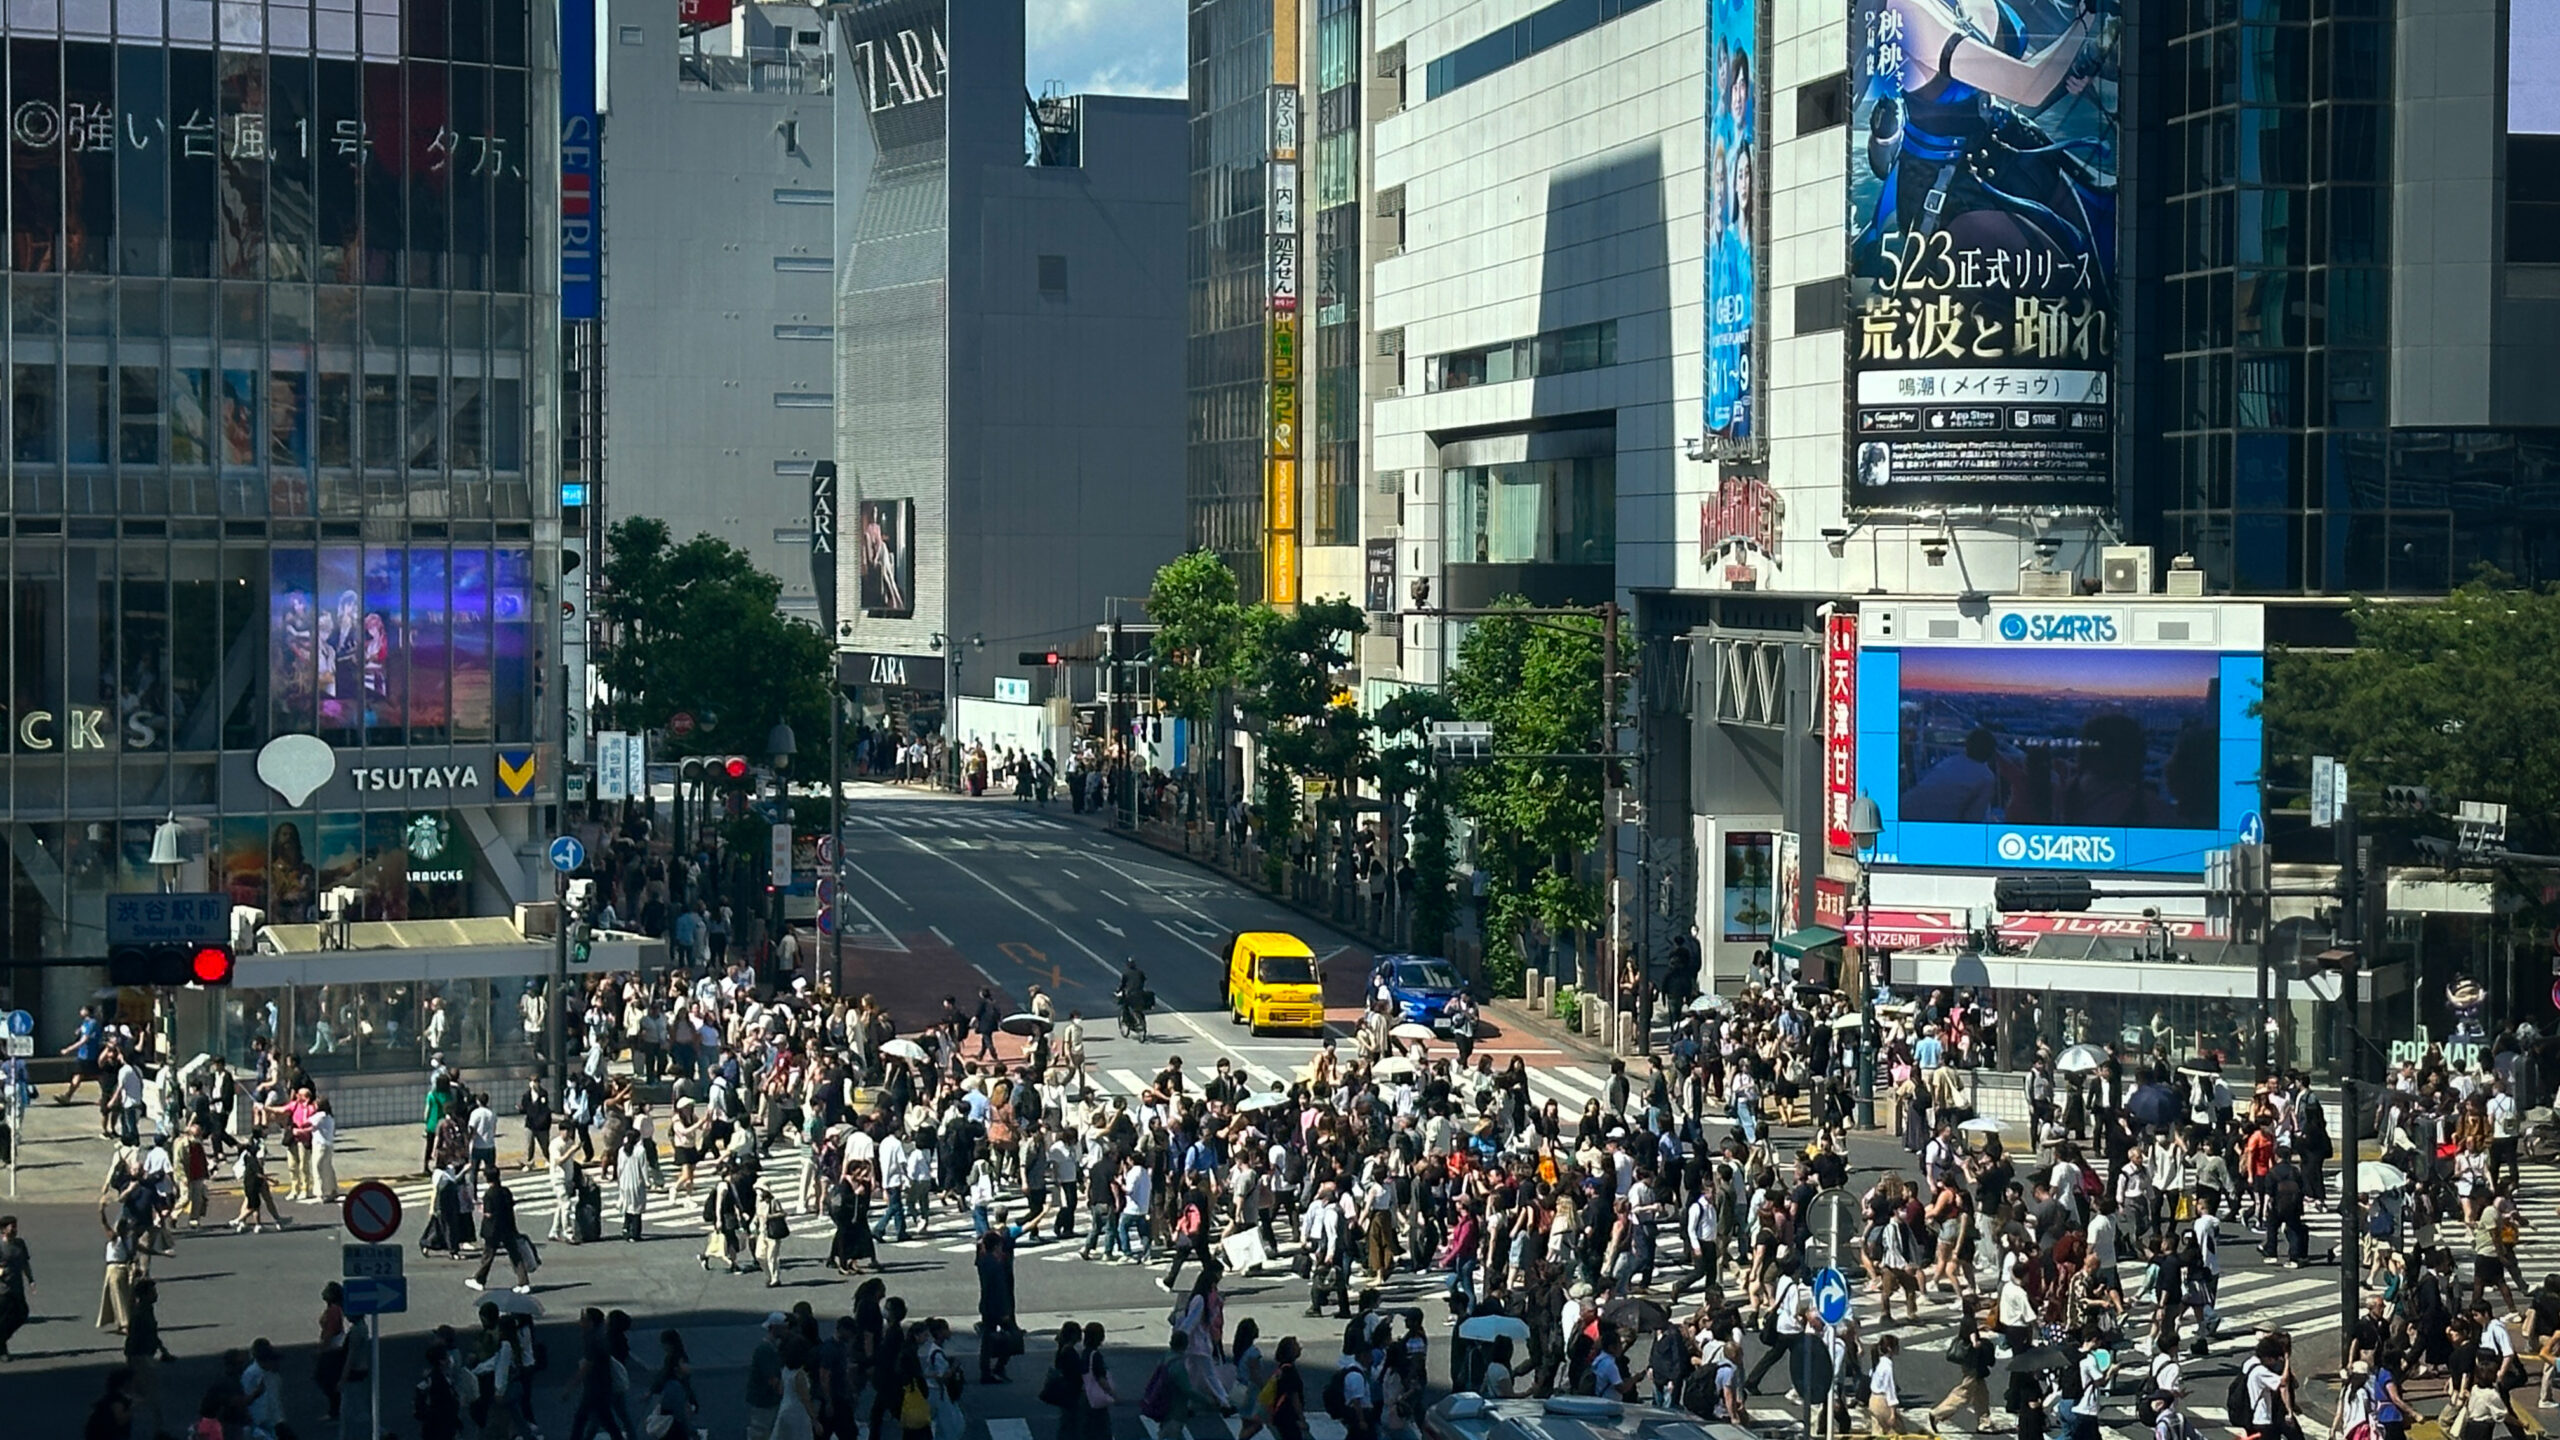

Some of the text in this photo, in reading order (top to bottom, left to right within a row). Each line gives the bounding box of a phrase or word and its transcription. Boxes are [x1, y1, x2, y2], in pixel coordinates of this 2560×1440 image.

[855, 25, 947, 112] ZARA
[1276, 90, 1294, 148] 皮ふ科
[1275, 186, 1293, 229] 内科
[1274, 237, 1293, 295] 処方せん
[1857, 294, 2108, 361] 荒波と踊れ
[1950, 410, 1995, 422] App Store
[813, 476, 832, 553] ZARA
[870, 656, 906, 685] ZARA
[352, 765, 479, 791] TSUTAYA
[117, 899, 221, 922] 渋谷駅前
